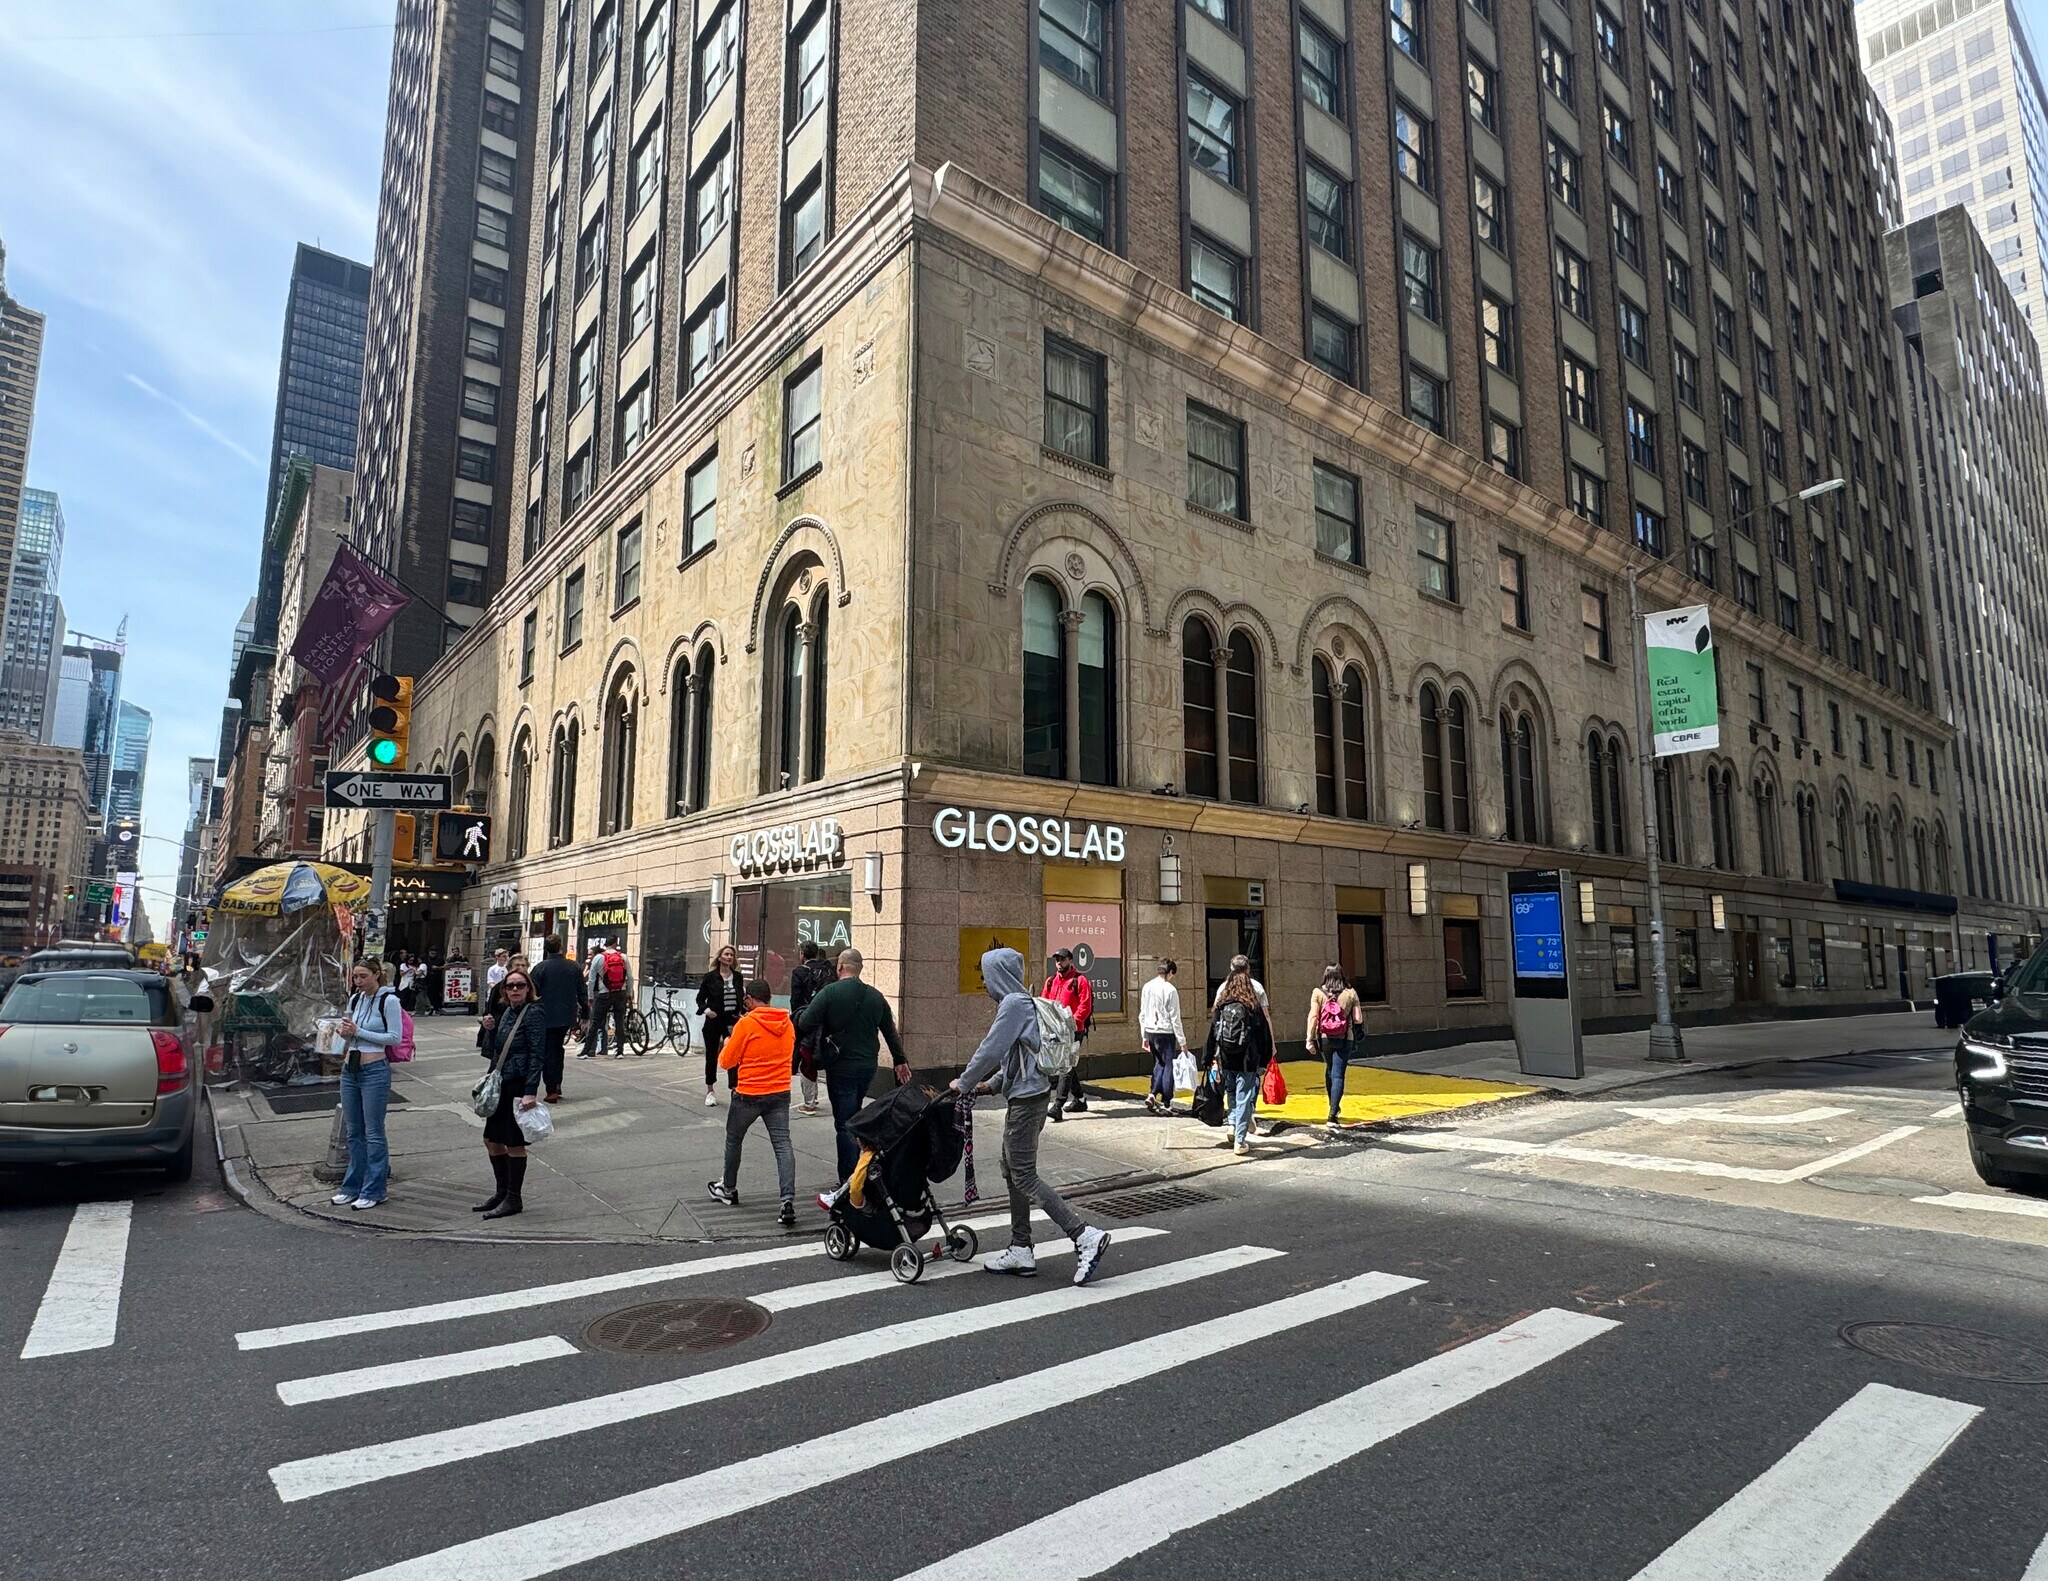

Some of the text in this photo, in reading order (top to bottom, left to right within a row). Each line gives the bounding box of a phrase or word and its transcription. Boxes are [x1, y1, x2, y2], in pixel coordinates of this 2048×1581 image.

[1666, 615, 1689, 626] NYC
[304, 632, 331, 662] PARK
[312, 620, 357, 668] CENTRAL
[319, 640, 352, 675] HOTEL
[1656, 676, 1679, 687] Real
[1657, 687, 1687, 697] estate
[1658, 695, 1691, 708] capital
[1658, 706, 1687, 717] of the
[1659, 715, 1688, 727] world
[1672, 732, 1701, 743] CBRE
[346, 782, 437, 799] ONE WAY
[932, 806, 1126, 862] GLOSSLAB
[730, 817, 840, 868] GLOSSLAB
[489, 882, 518, 910] GIFTS
[220, 899, 279, 912] SABRETT
[589, 910, 611, 927] FANCY
[1059, 913, 1108, 924] BETTER AS
[1057, 927, 1065, 935] A
